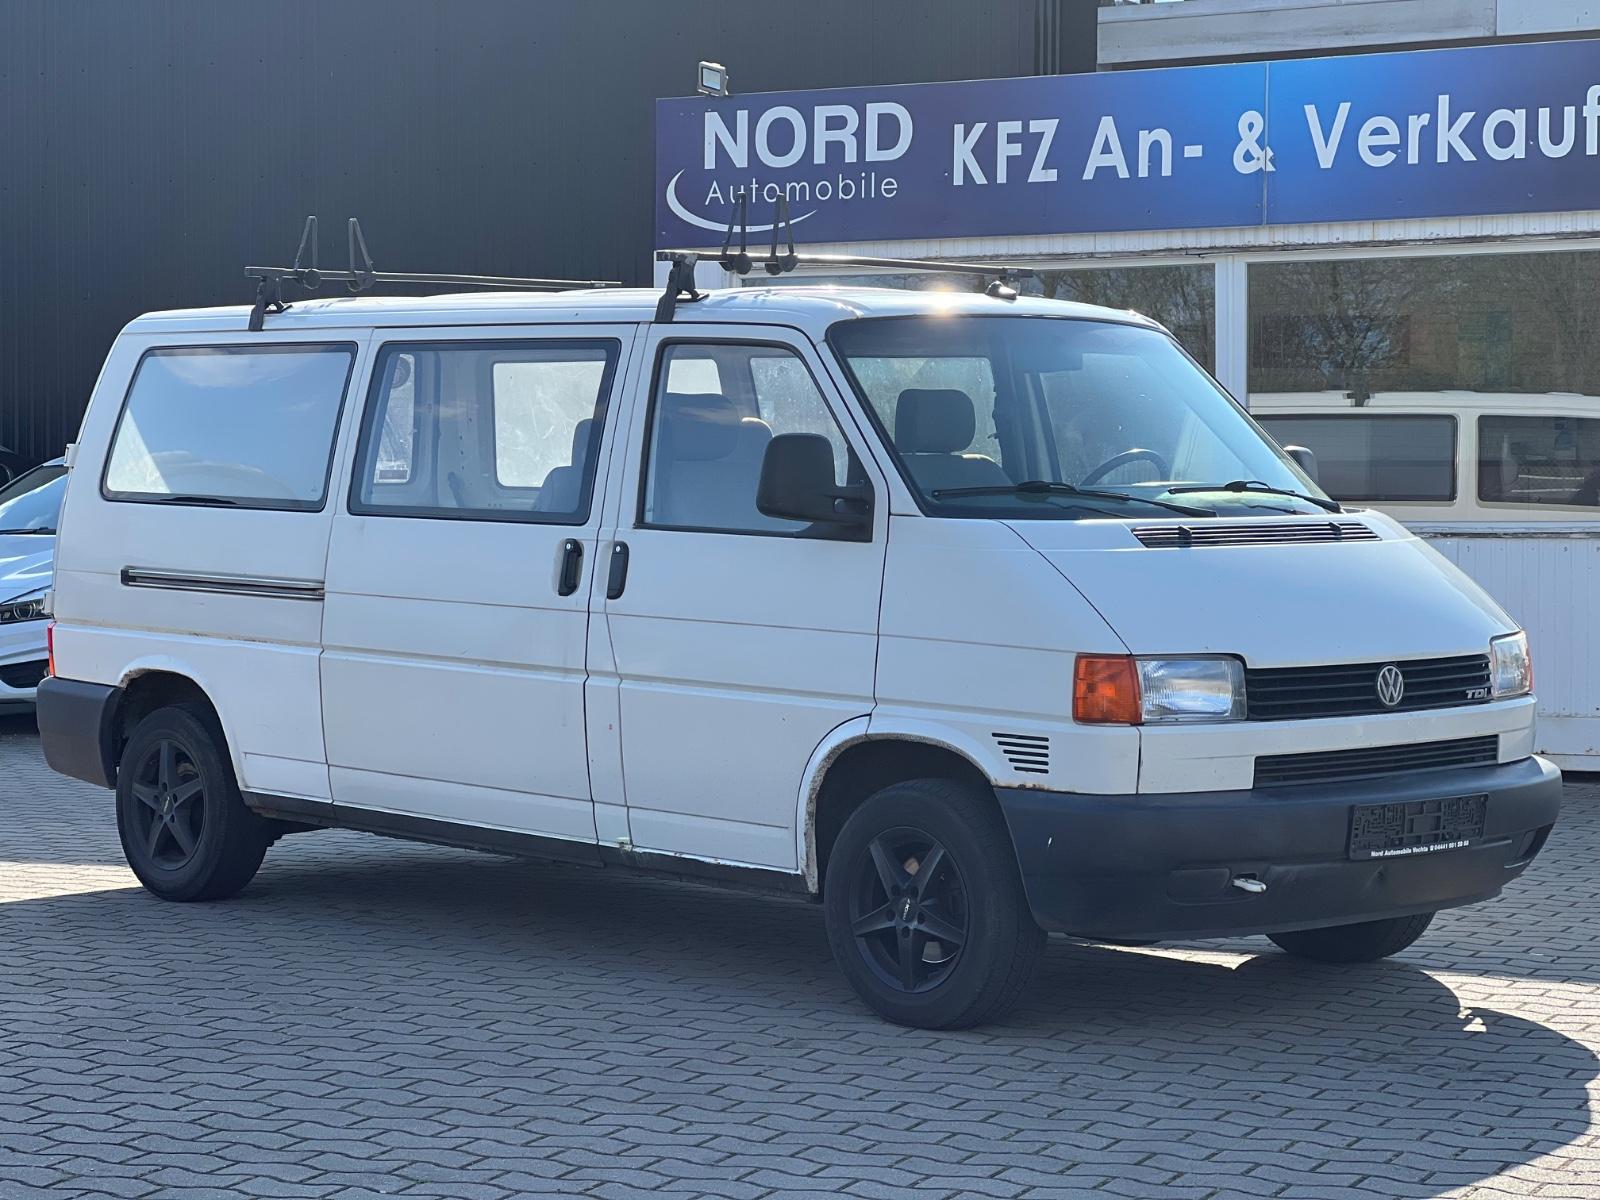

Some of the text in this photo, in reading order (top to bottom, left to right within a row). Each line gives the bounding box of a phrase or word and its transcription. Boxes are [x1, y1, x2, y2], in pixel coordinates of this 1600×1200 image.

[704, 102, 914, 171] NORD
[952, 85, 1600, 187] KFZ An- & Verkauf
[704, 172, 899, 206] Automobile
[1466, 688, 1488, 699] TDI
